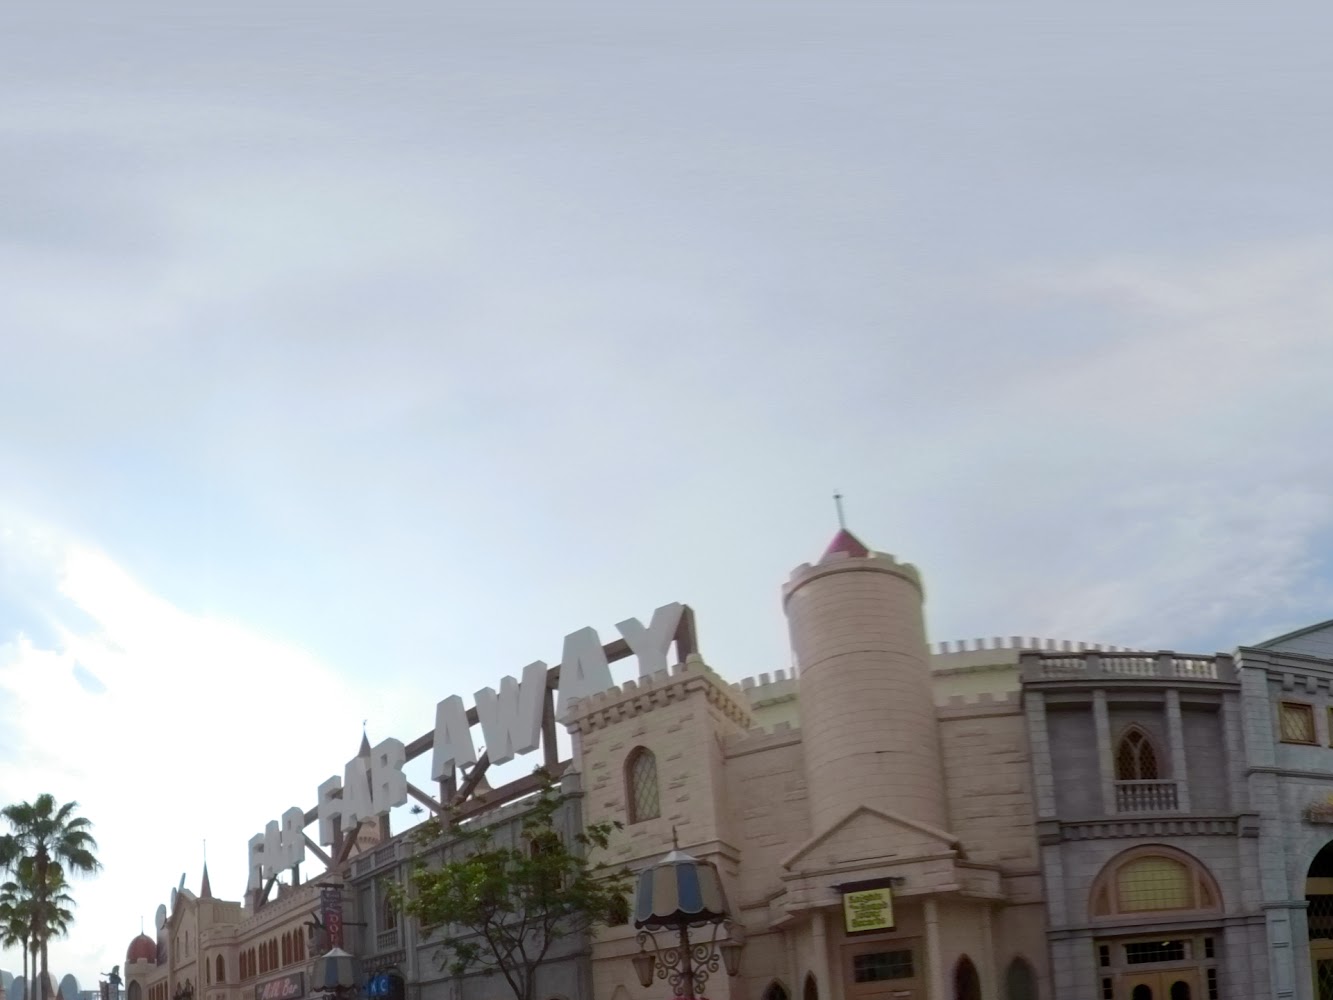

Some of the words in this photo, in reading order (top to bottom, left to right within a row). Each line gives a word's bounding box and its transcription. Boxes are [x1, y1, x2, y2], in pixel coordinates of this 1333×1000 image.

[248, 806, 305, 890] FAR
[318, 737, 408, 846] FAR
[431, 601, 690, 782] AWAY
